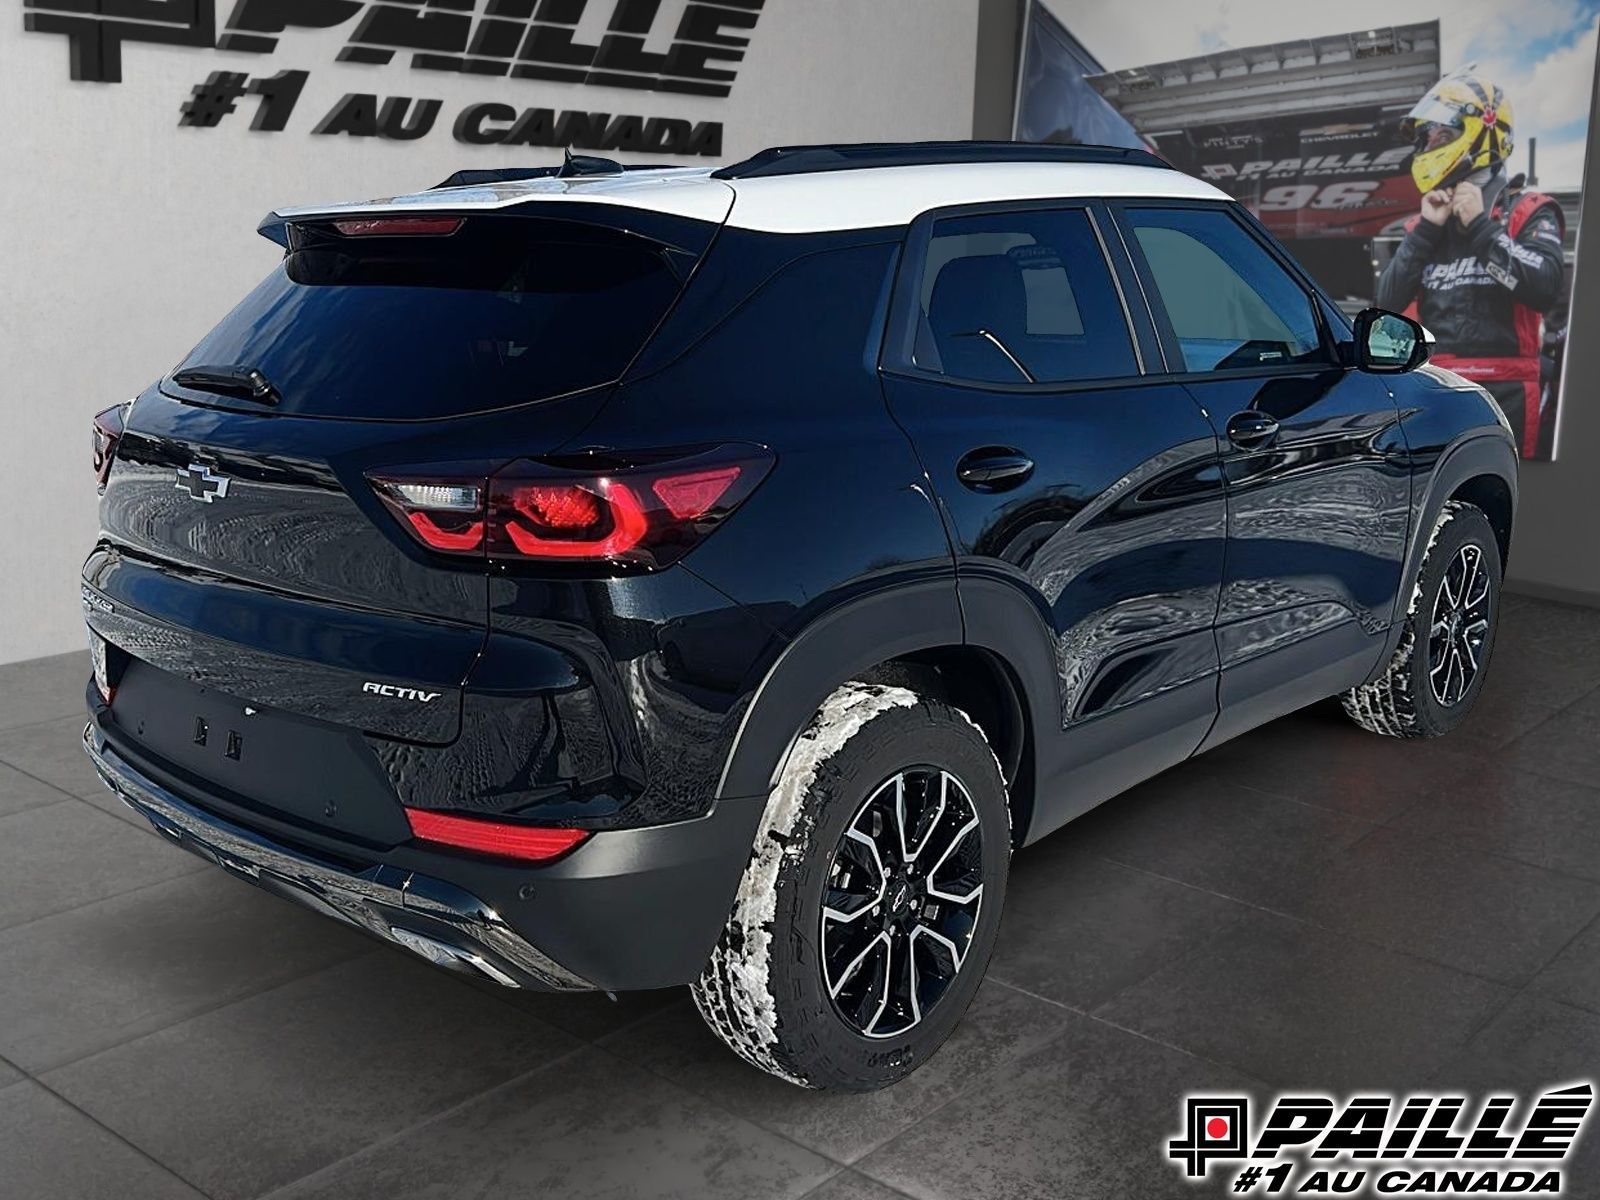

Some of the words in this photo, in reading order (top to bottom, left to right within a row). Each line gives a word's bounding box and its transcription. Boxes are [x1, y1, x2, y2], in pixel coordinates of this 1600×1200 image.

[178, 69, 310, 131] #1
[310, 93, 444, 140] AU
[452, 103, 723, 157] CANADA
[1300, 131, 1379, 144] CHEVROLET
[1266, 170, 1297, 180] AU
[1303, 163, 1400, 177] CANADA
[1258, 181, 1380, 211] 96
[363, 682, 442, 702] ACTIV
